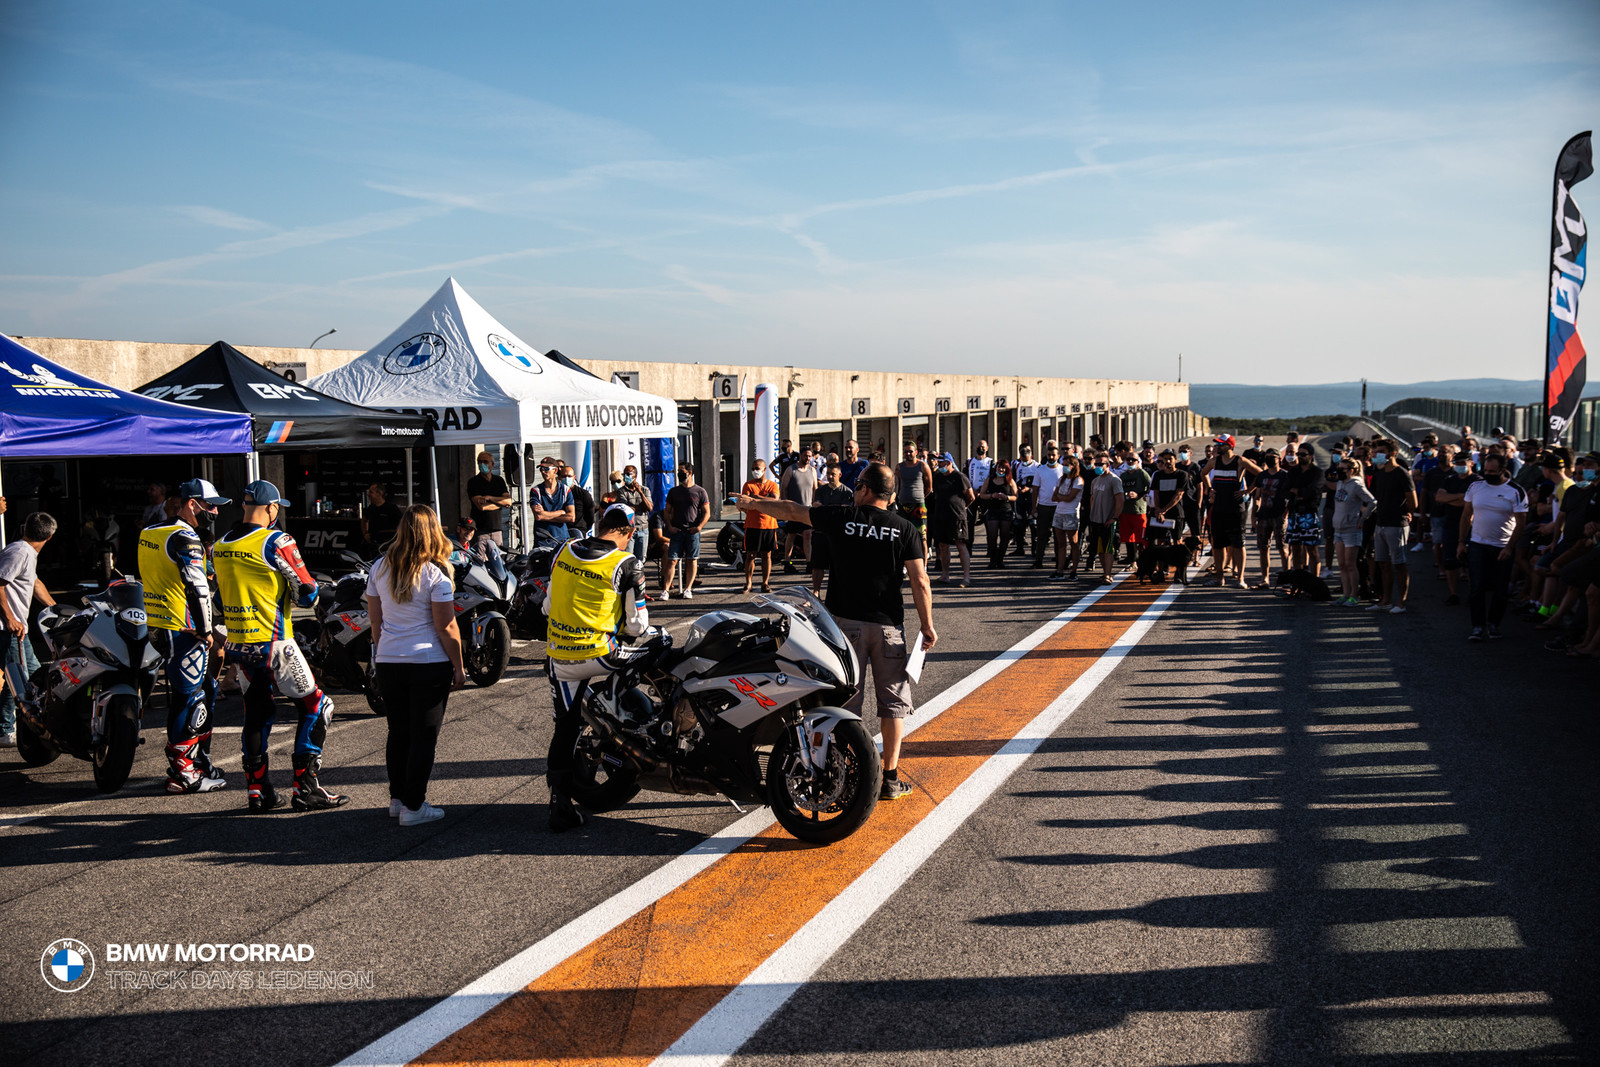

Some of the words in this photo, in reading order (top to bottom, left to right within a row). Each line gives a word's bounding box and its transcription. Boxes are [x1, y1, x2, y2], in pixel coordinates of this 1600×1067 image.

[15, 387, 120, 399] MICHELIN
[247, 383, 320, 401] BMC
[721, 378, 731, 397] 6
[857, 400, 866, 415] 8
[903, 400, 911, 413] 9
[937, 399, 950, 412] 10
[968, 398, 979, 409] 11
[994, 397, 1006, 408] 12
[1072, 404, 1081, 413] 16
[1085, 404, 1093, 412] 17
[804, 402, 813, 418] 7
[1039, 408, 1048, 417] 14
[1056, 406, 1066, 415] 15
[542, 405, 581, 428] BMW
[586, 405, 663, 427] MOTORRAD
[844, 521, 901, 542] STAFF
[304, 530, 350, 549] BMC
[127, 610, 146, 621] 103
[557, 643, 596, 652] MICHELIN
